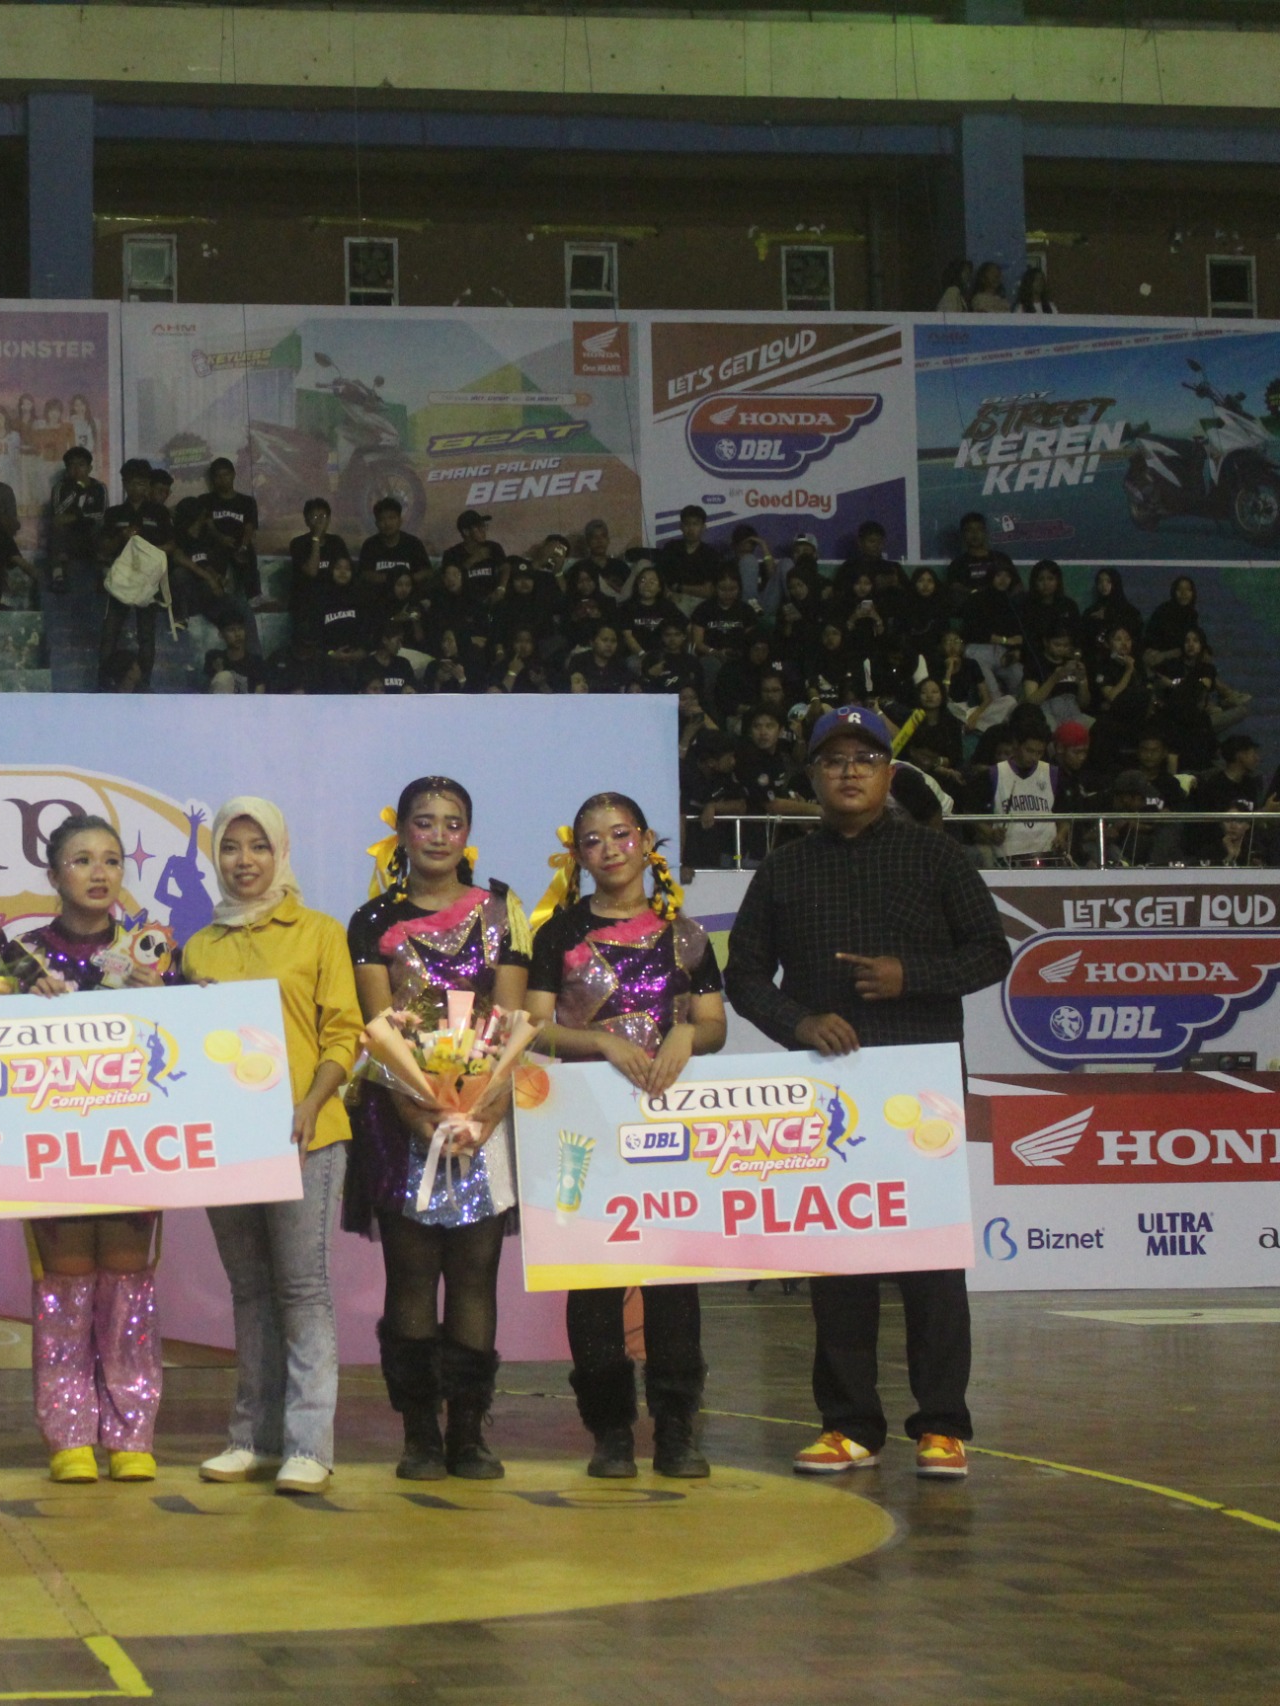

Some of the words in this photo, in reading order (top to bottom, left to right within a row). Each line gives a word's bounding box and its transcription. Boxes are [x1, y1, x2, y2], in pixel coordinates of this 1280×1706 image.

[668, 366, 714, 399] LET'S
[718, 348, 759, 380] GET
[758, 330, 817, 371] LOUD
[739, 412, 835, 426] HONDA
[737, 439, 785, 460] DBL
[954, 420, 1127, 468] KEREN
[427, 464, 491, 481] EMANG
[495, 457, 561, 474] PALING
[981, 454, 1101, 496] KAN!
[466, 469, 603, 505] BENER
[1063, 898, 1131, 929] LET'S
[1135, 896, 1195, 927] GET
[1200, 894, 1276, 927] LOUD
[1084, 962, 1239, 983] HONDA
[1087, 1006, 1162, 1039] DBL
[10, 1050, 149, 1109] DANCE
[48, 1090, 148, 1114] Competition
[25, 1122, 216, 1181] PLACE
[643, 1131, 680, 1150] DBL
[692, 1113, 824, 1172] DANCE
[729, 1155, 827, 1180] Competition
[722, 1180, 908, 1237] PLACE
[1138, 1212, 1214, 1233] ULTRA
[1027, 1229, 1104, 1249] Biznet
[1146, 1234, 1207, 1256] MILK
